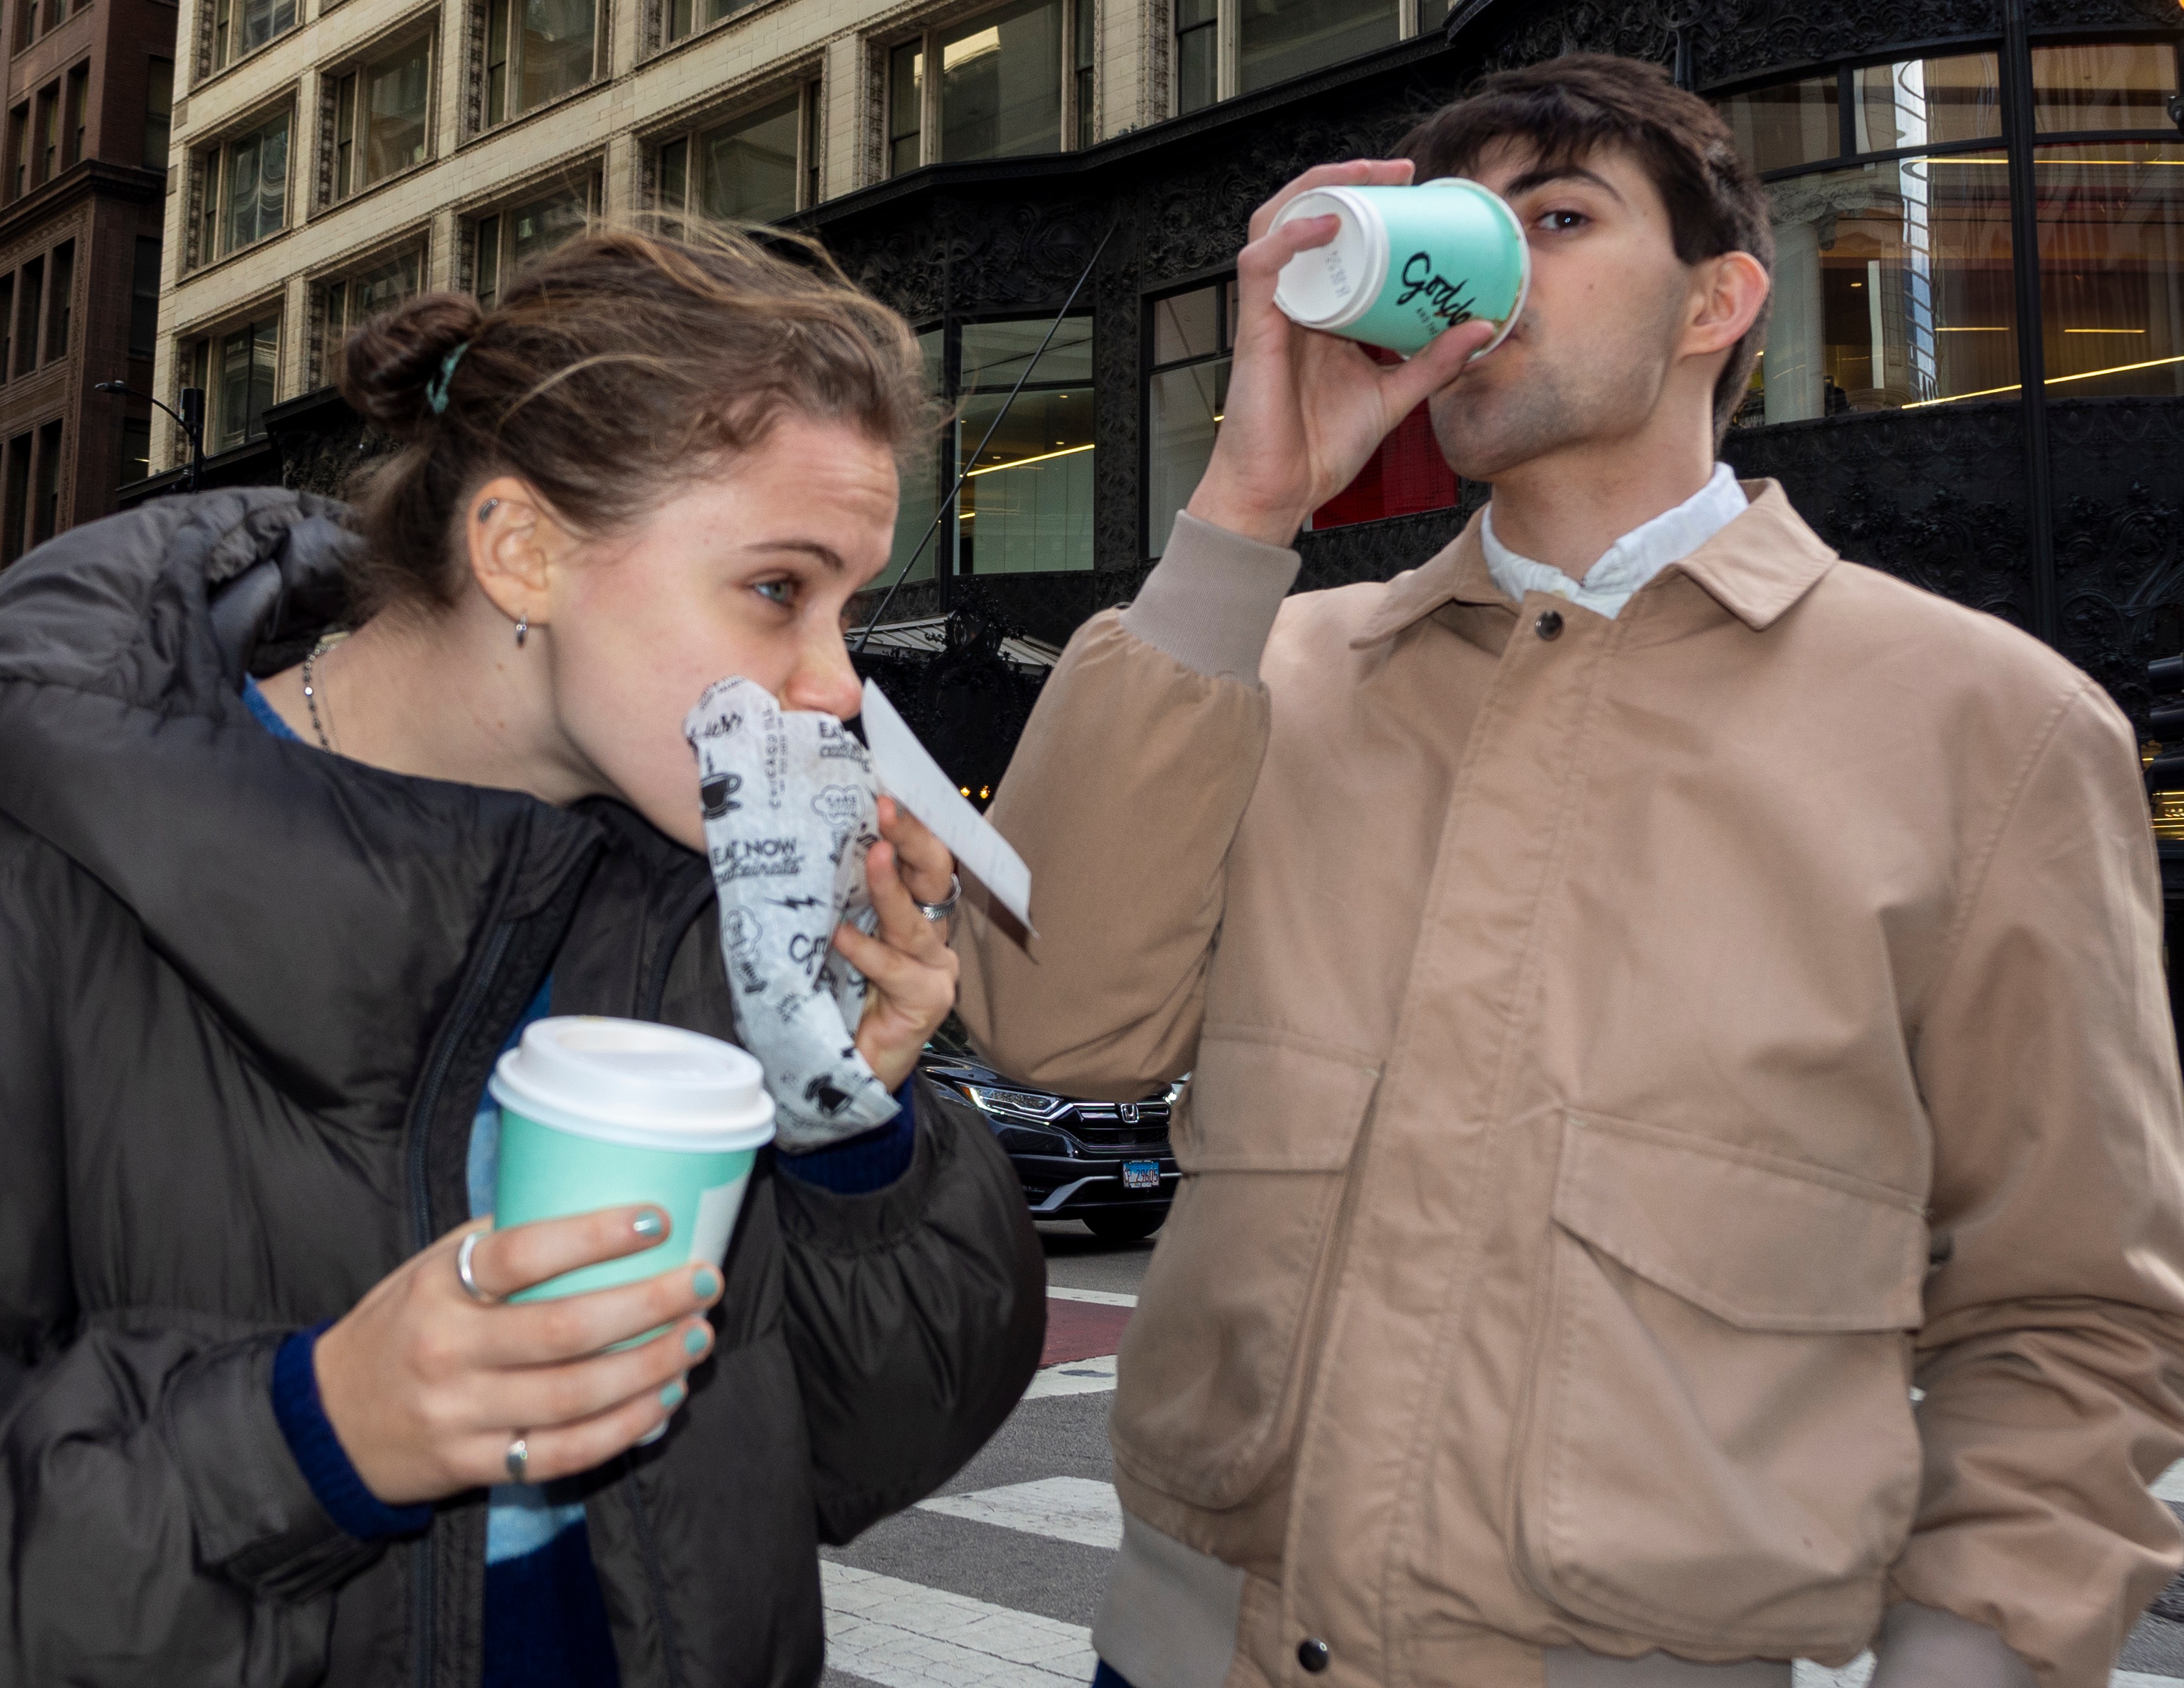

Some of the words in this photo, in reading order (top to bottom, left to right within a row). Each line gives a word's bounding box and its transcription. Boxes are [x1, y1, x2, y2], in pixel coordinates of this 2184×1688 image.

[1396, 251, 1476, 327] Godde
[743, 836, 798, 858] NOW
[1136, 1168, 1159, 1183] 29605
